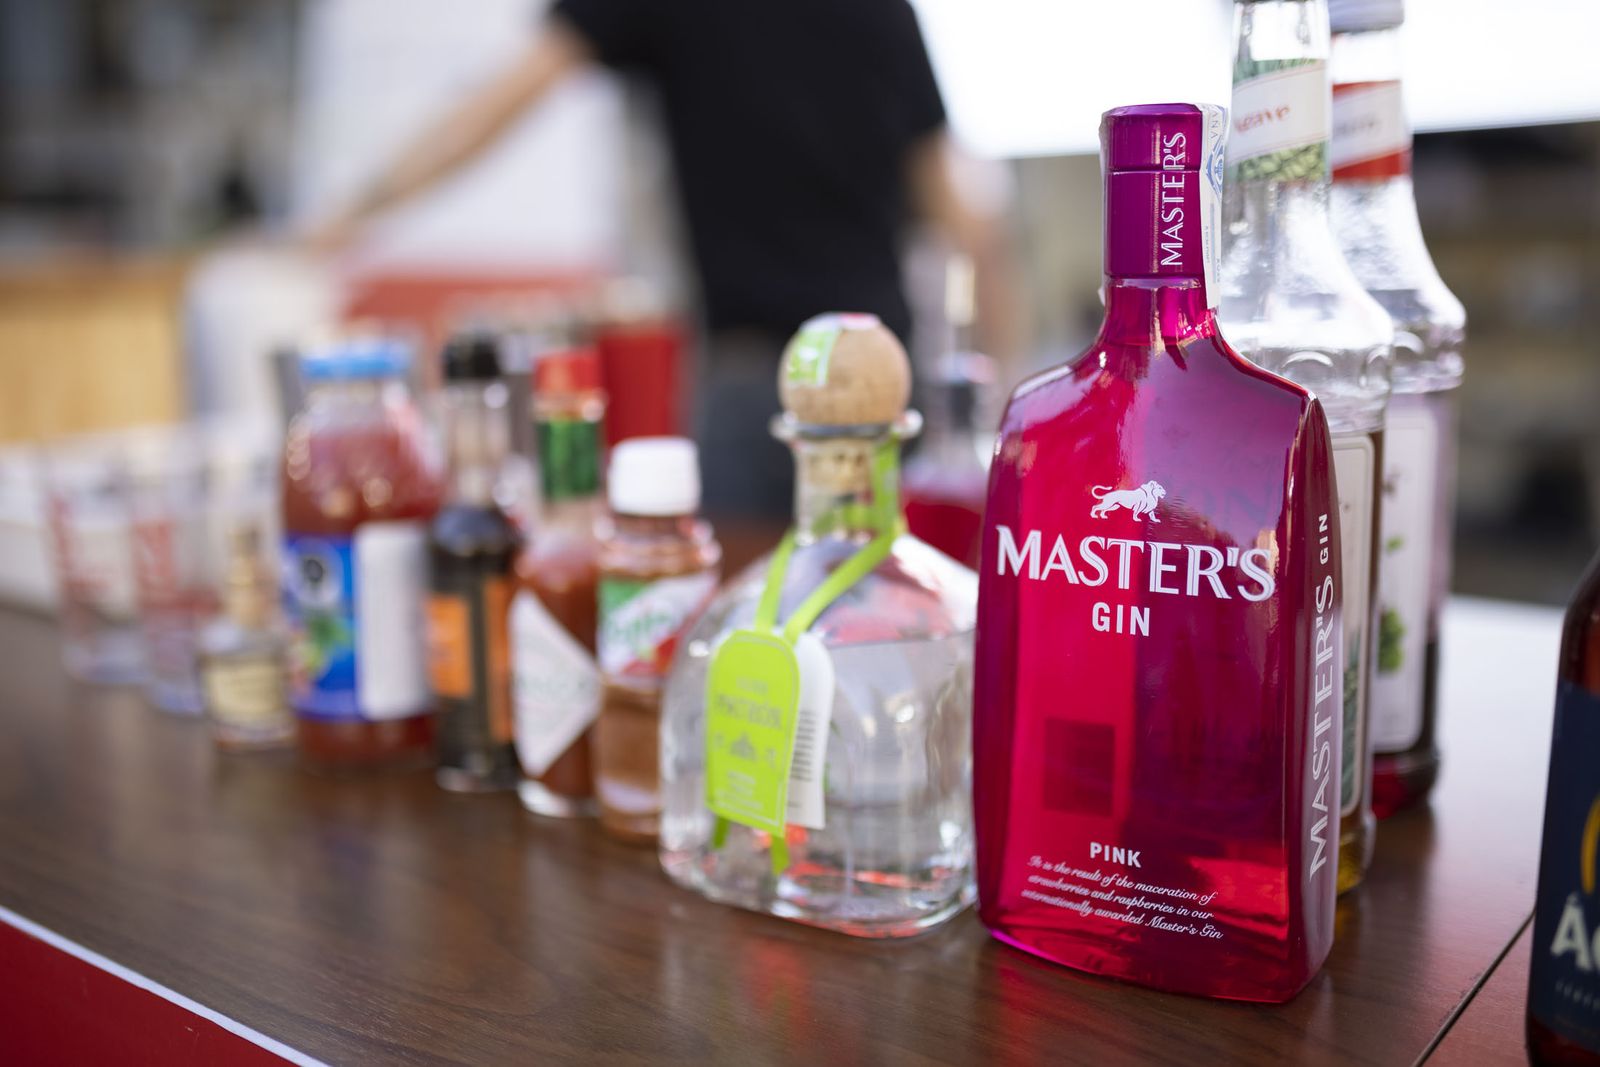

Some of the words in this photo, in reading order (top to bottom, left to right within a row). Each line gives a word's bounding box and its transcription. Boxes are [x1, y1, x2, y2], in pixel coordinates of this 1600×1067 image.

[1160, 131, 1187, 266] MASTER'S
[996, 524, 1276, 602] MASTER'S
[1318, 513, 1329, 565] GIN
[1092, 602, 1150, 637] GIN
[1309, 574, 1334, 882] MASTER'S
[1089, 841, 1142, 868] PINK
[1027, 874, 1092, 896] strawberries
[1090, 889, 1115, 902] and
[1112, 895, 1176, 914] raspberries
[1176, 905, 1191, 916] in
[1190, 910, 1215, 920] our
[1053, 861, 1072, 875] the
[1070, 869, 1102, 882] result
[1100, 873, 1119, 887] of
[1115, 875, 1134, 889] the
[1134, 882, 1200, 901] maceration
[1198, 891, 1219, 905] of
[1020, 888, 1095, 917] internationally
[1094, 907, 1146, 925] awarded
[1145, 915, 1199, 936] Master's
[1199, 922, 1224, 939] Gin
